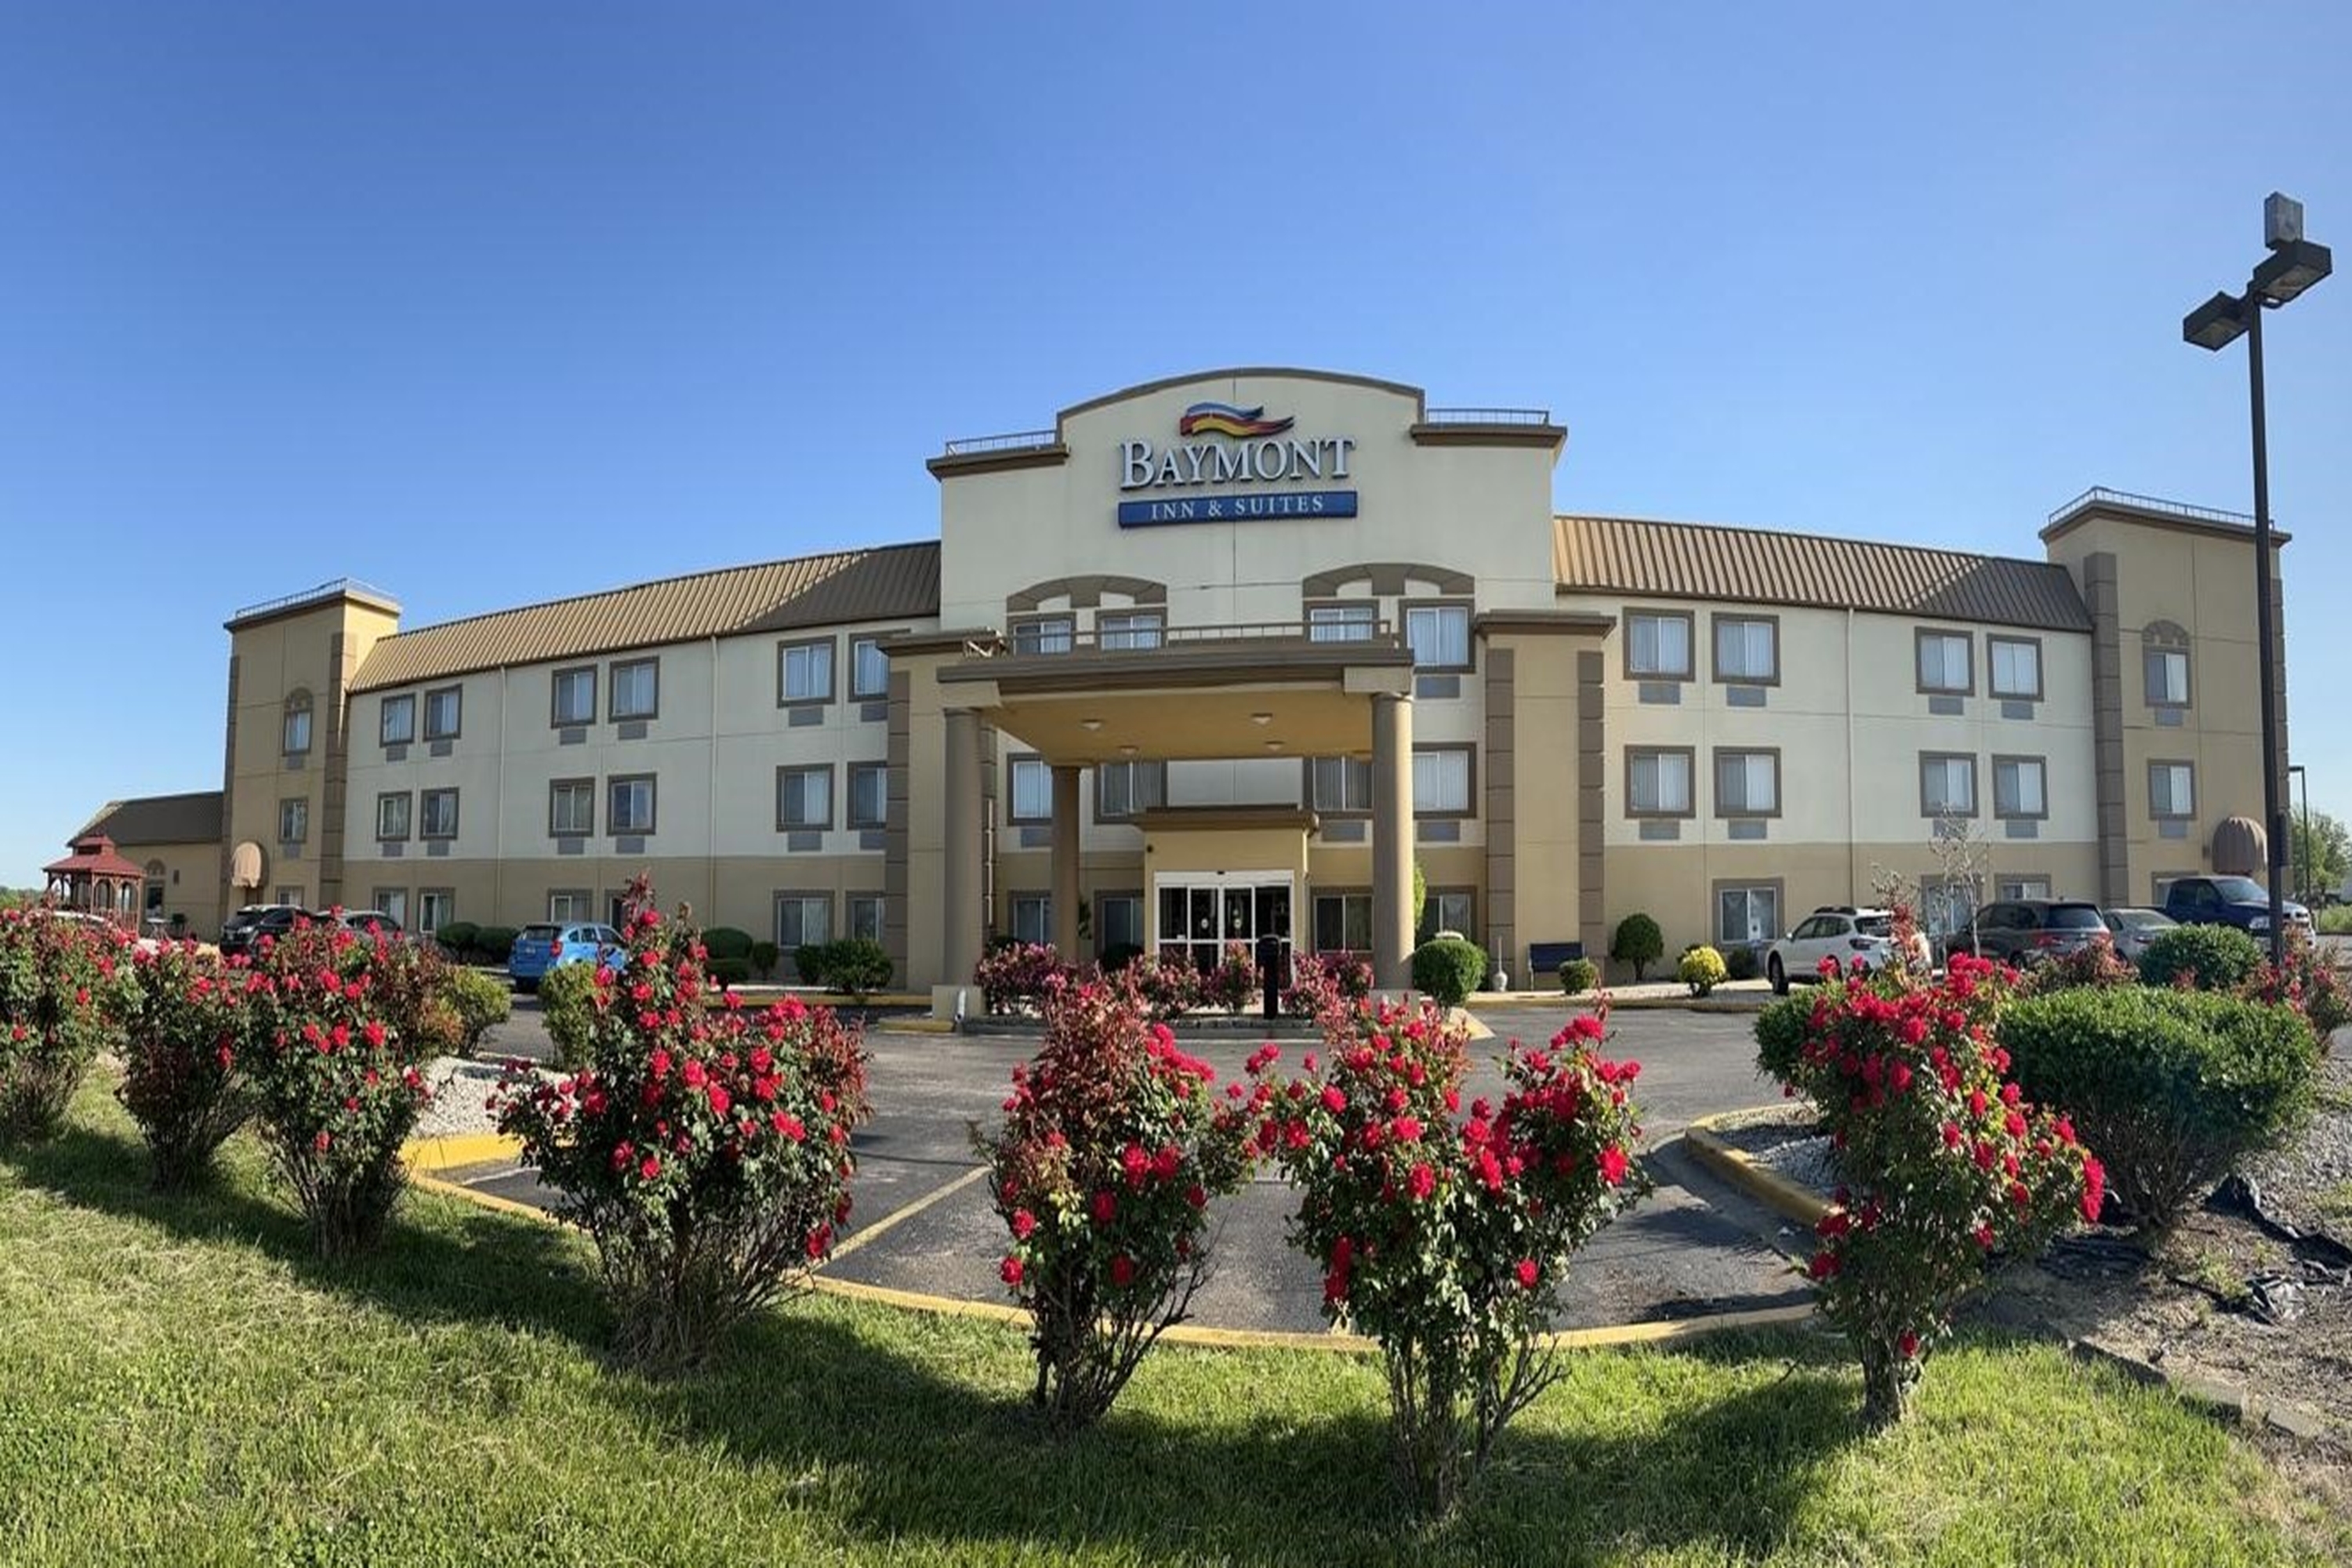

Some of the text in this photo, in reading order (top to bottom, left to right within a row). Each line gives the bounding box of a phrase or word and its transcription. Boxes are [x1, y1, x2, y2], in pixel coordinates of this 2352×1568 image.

[1120, 438, 1355, 489] BAYMONT
[1151, 495, 1324, 521] INN & SUITES
